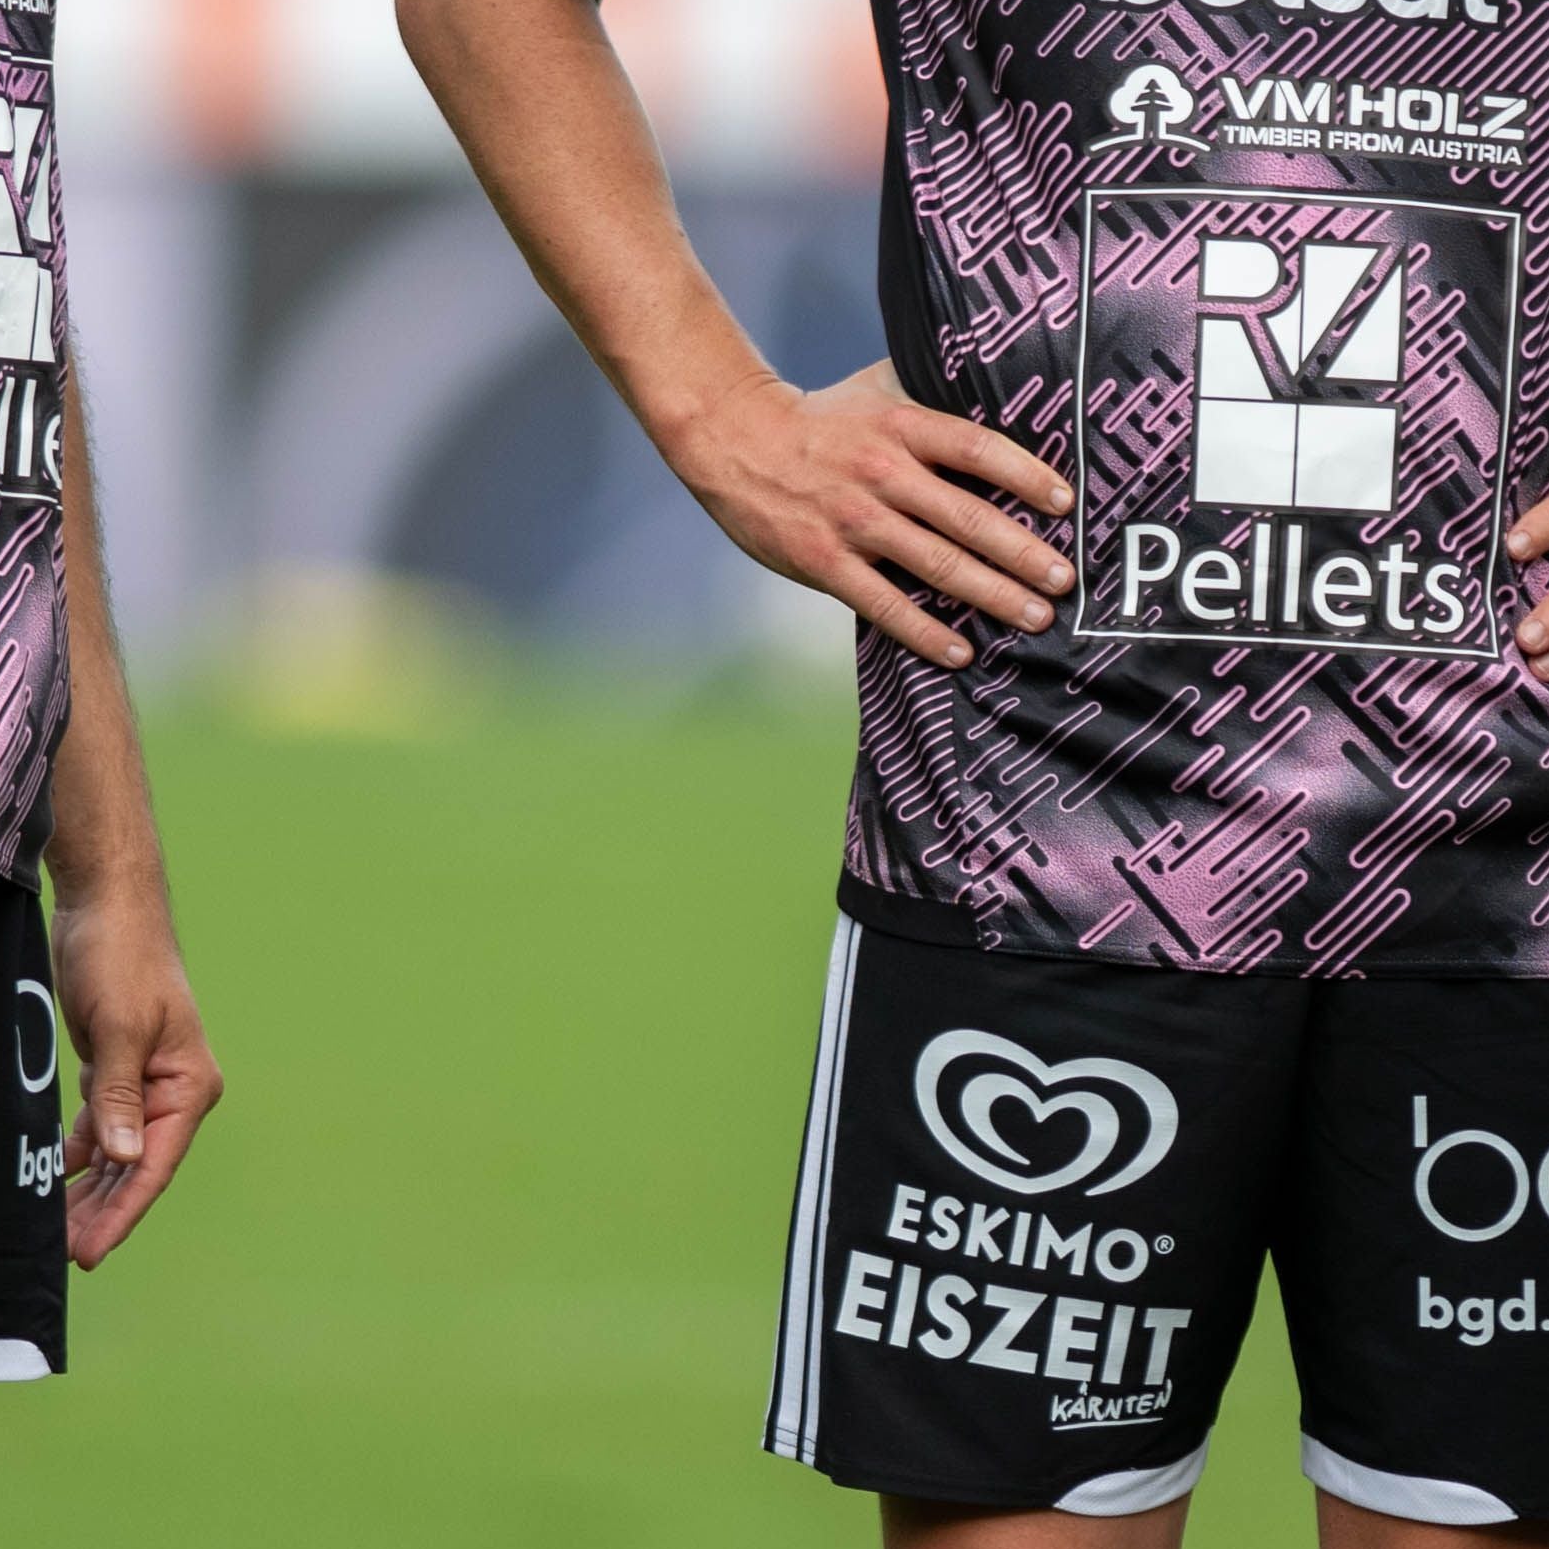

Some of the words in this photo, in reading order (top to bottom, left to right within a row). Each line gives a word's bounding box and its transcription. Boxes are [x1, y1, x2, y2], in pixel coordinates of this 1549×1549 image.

[1221, 77, 1332, 123] VM
[1351, 84, 1528, 141] HOLZ
[1223, 124, 1322, 149] TIMBER
[1327, 130, 1404, 155] FROM
[1408, 139, 1524, 166] AUSTRIA
[1122, 515, 1467, 634] Pellets
[835, 1250, 1193, 1386] EISZEIT
[1051, 1379, 1173, 1423] KÄRNTEN
